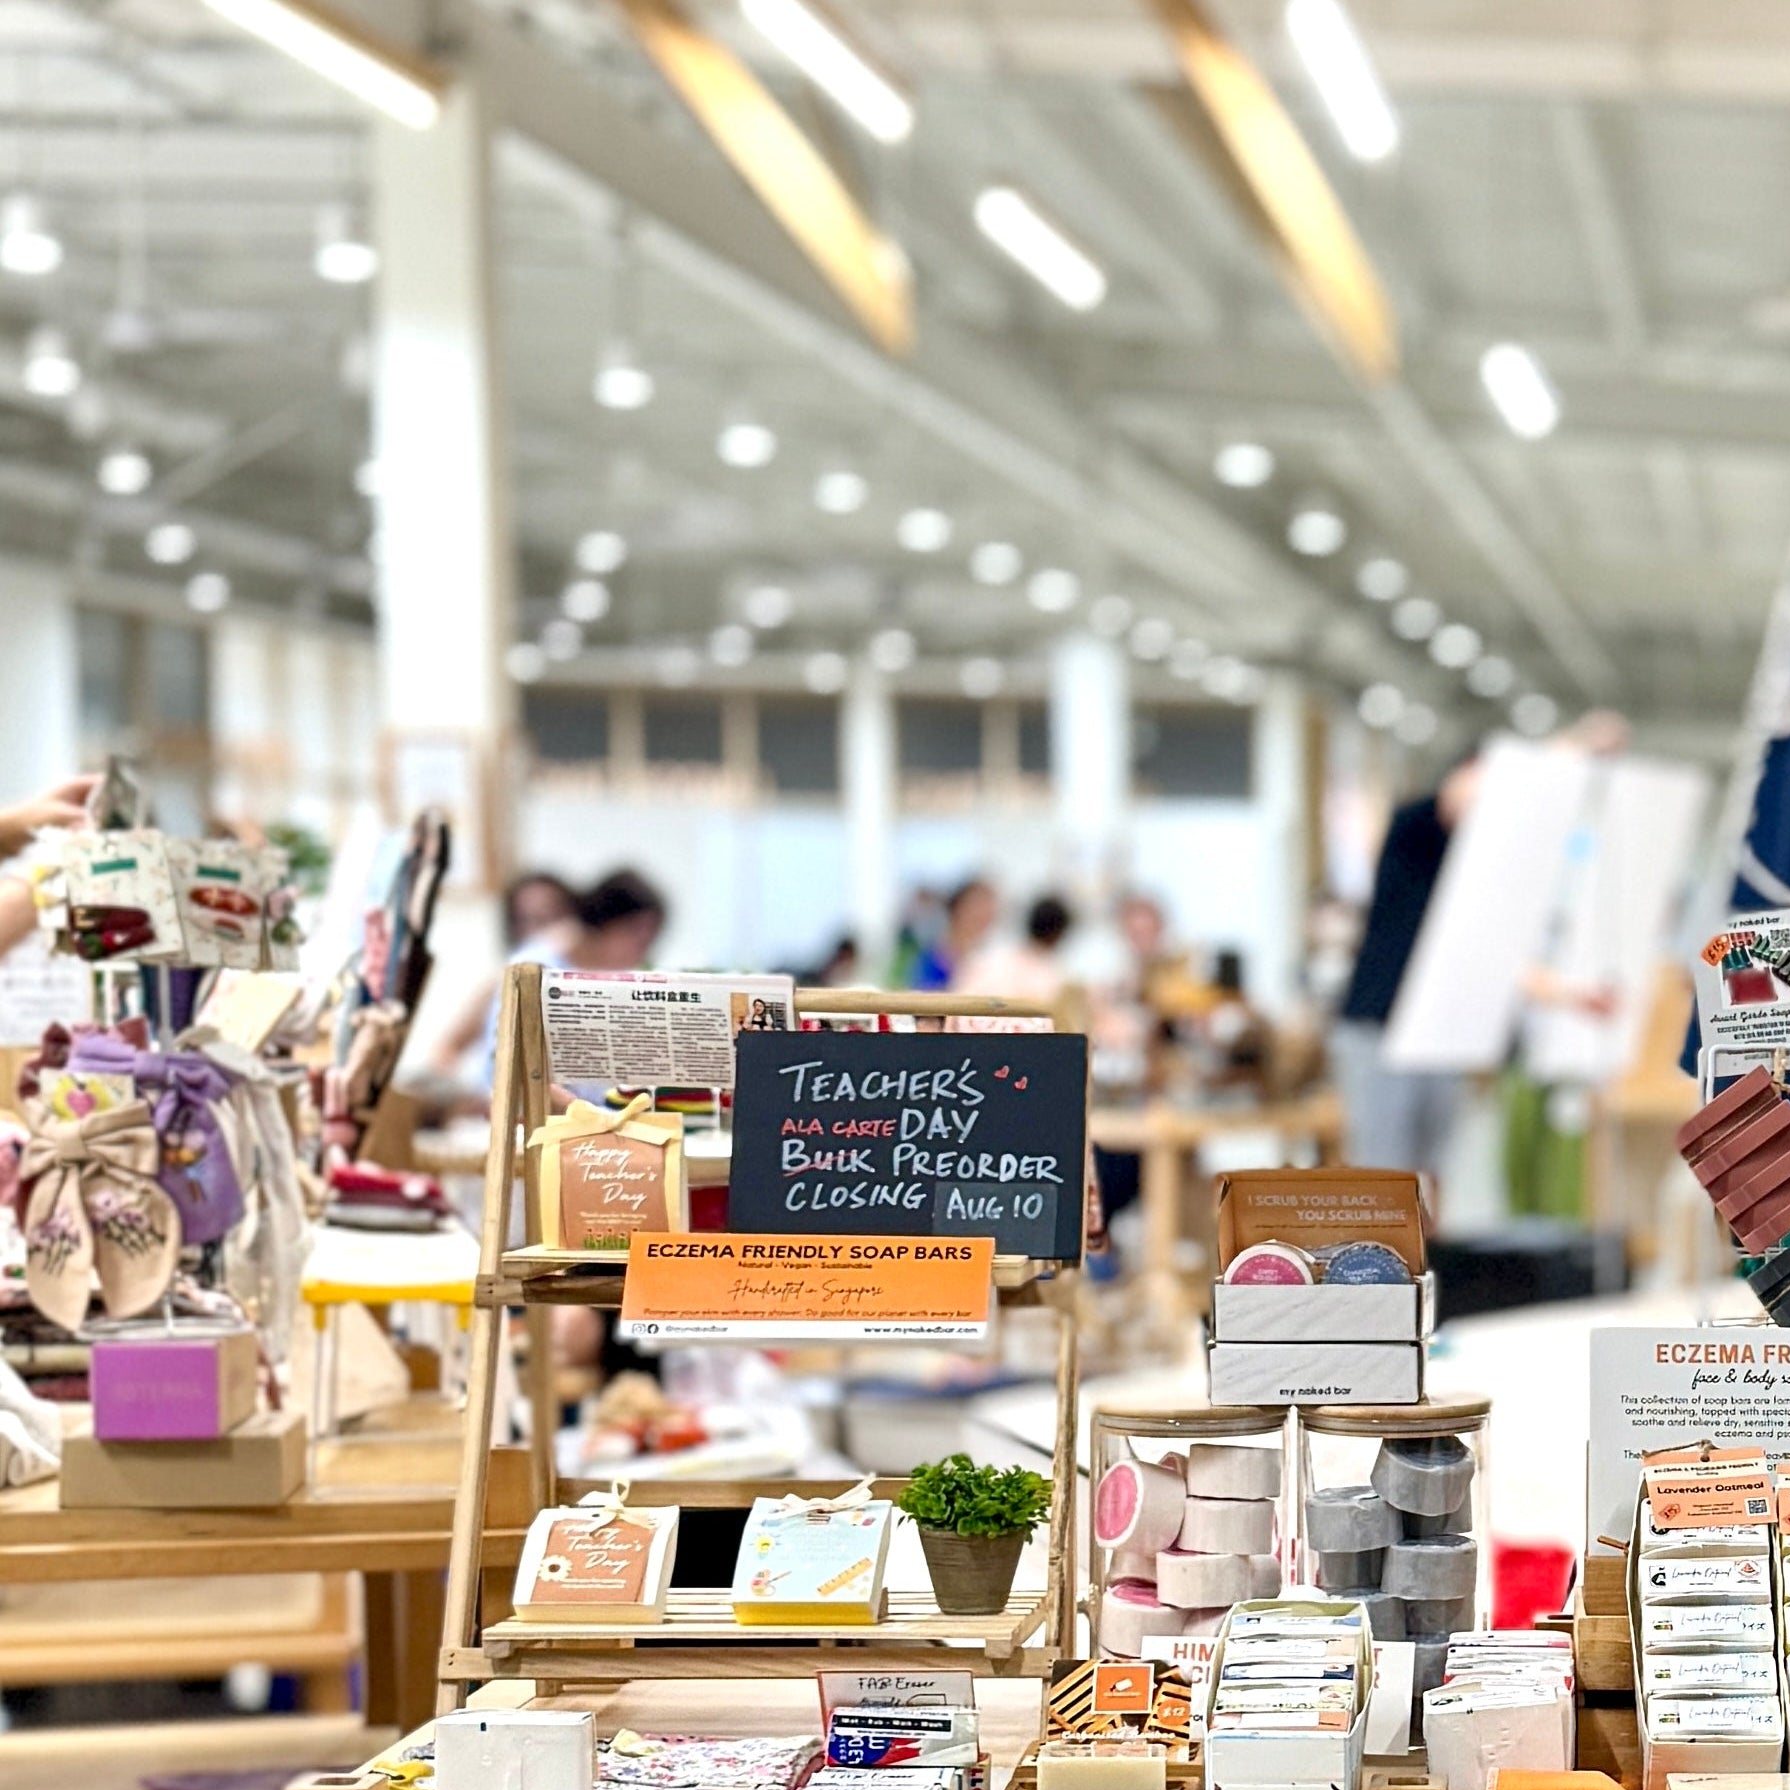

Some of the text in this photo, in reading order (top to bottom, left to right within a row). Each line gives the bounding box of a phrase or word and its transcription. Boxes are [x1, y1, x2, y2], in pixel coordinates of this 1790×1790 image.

[779, 1059, 985, 1105] TEACHER'S
[781, 1108, 980, 1145] ALA CARTE DAY
[572, 1140, 632, 1166] Happy
[892, 1143, 1064, 1184] PREORDER
[580, 1163, 658, 1183] Teacher's
[601, 1182, 648, 1211] Day
[785, 1182, 1044, 1221] CLOSING AUG 10
[1254, 1194, 1298, 1207] SCRUB
[1302, 1195, 1338, 1207] YOUR
[1341, 1195, 1378, 1207] BACK
[1296, 1210, 1326, 1222] YOU
[1328, 1209, 1373, 1222] SCRUB
[647, 1243, 972, 1260] ECZEMA FRIENDLY SOAP BARS
[1656, 1343, 1755, 1364] ECZEMA
[1691, 1369, 1722, 1390] face
[1724, 1368, 1738, 1384] &
[1743, 1369, 1778, 1391] body
[1298, 1386, 1332, 1396] naked
[1333, 1386, 1352, 1395] bar
[1657, 1481, 1764, 1494] Lavender Oatmeal
